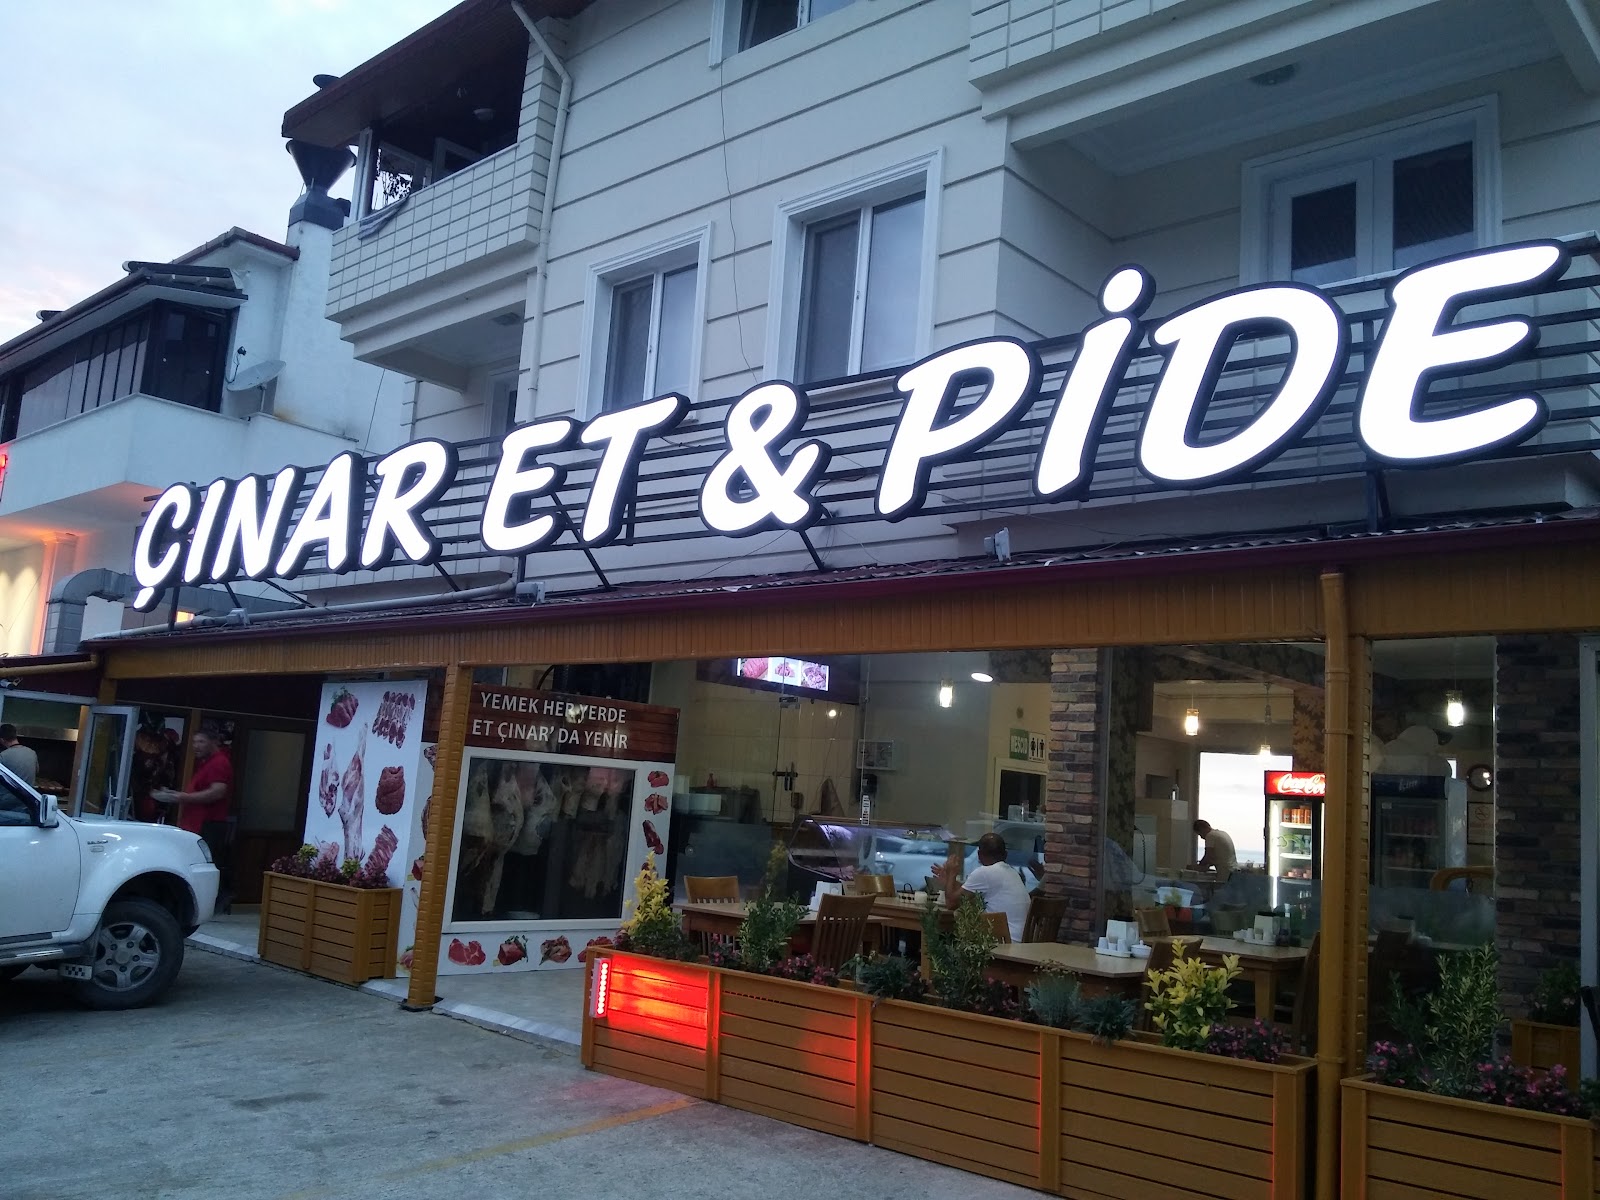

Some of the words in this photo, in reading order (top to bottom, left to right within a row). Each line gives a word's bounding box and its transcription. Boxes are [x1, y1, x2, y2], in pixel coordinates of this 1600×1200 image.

[134, 441, 448, 610] ÇINAR
[482, 396, 678, 551] ET
[701, 384, 819, 532] &
[878, 246, 1560, 514] PİDE
[481, 692, 539, 714] YEMEK
[543, 699, 574, 717] HER
[578, 704, 627, 724] YERDE
[472, 719, 494, 737] ET
[557, 728, 580, 745] DA
[584, 730, 628, 749] YENİR
